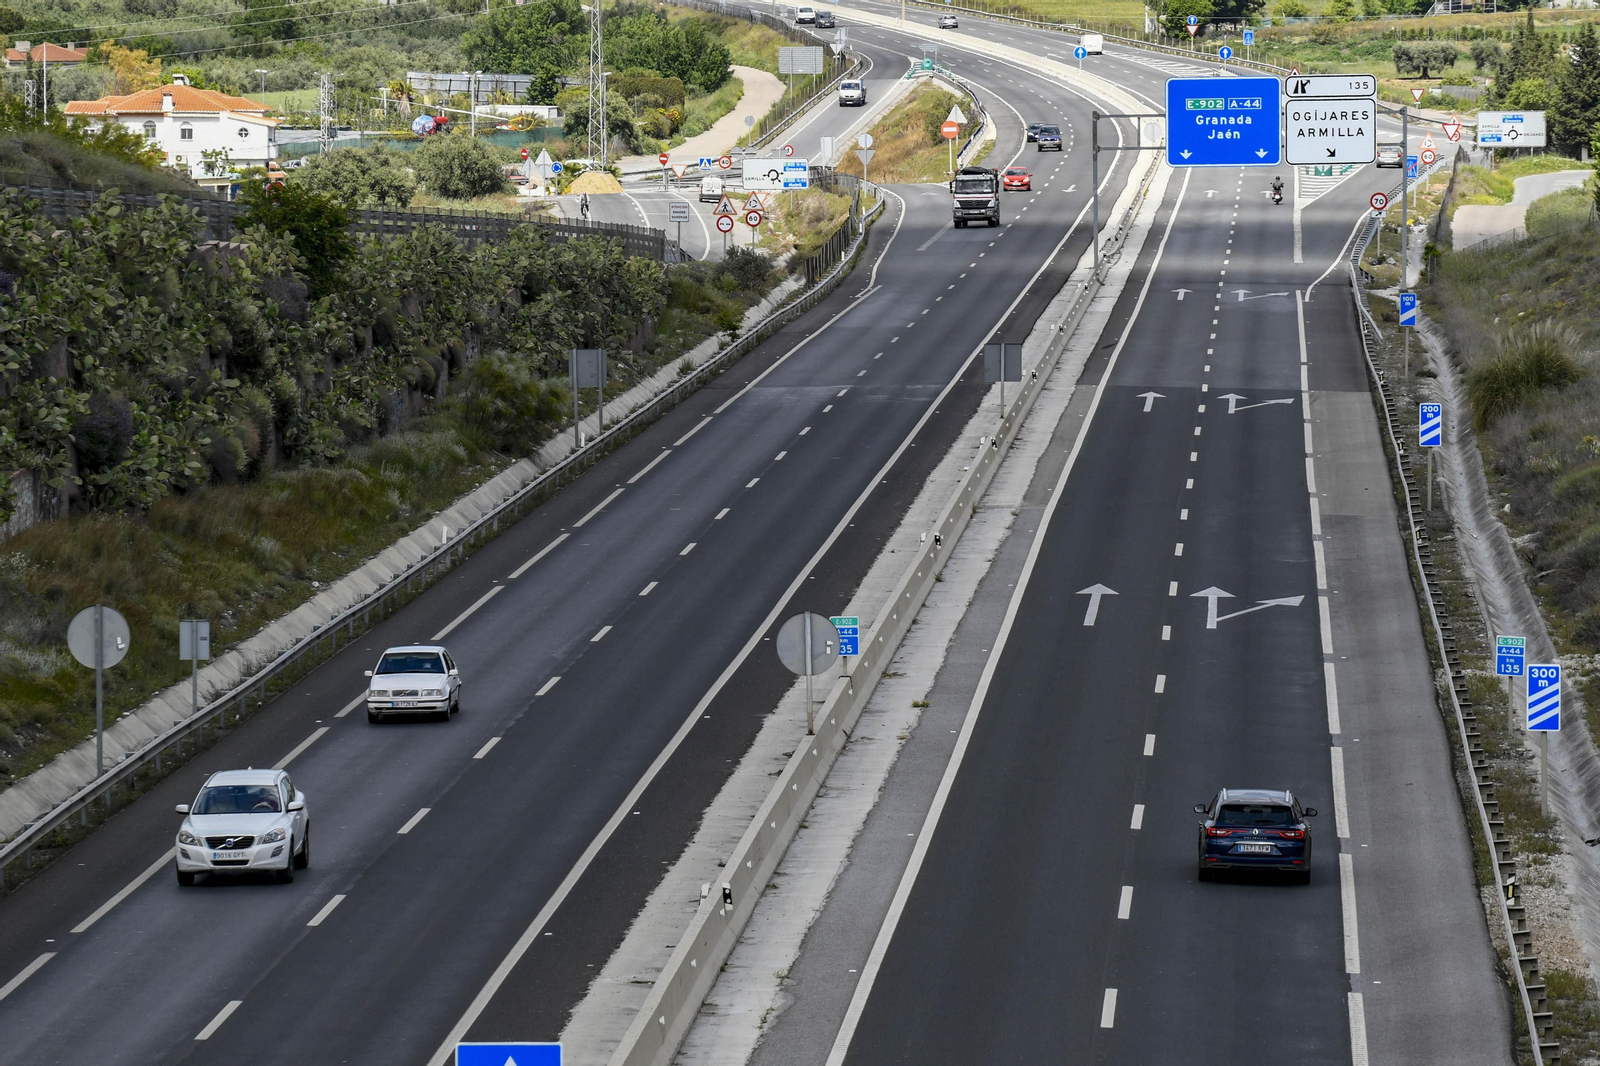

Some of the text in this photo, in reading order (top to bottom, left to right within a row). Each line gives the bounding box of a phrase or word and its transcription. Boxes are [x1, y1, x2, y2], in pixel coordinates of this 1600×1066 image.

[1349, 82, 1369, 90] 135
[1187, 99, 1260, 109] E-902 A-44
[1195, 115, 1252, 125] Granada
[1292, 109, 1369, 121] OGÍJARES
[1207, 129, 1241, 139] Jaén
[1297, 127, 1364, 137] ARMILLA
[1422, 405, 1439, 413] 200
[840, 644, 853, 654] 35
[1501, 664, 1520, 674] 135
[1531, 668, 1557, 678] 300
[1538, 679, 1549, 687] m
